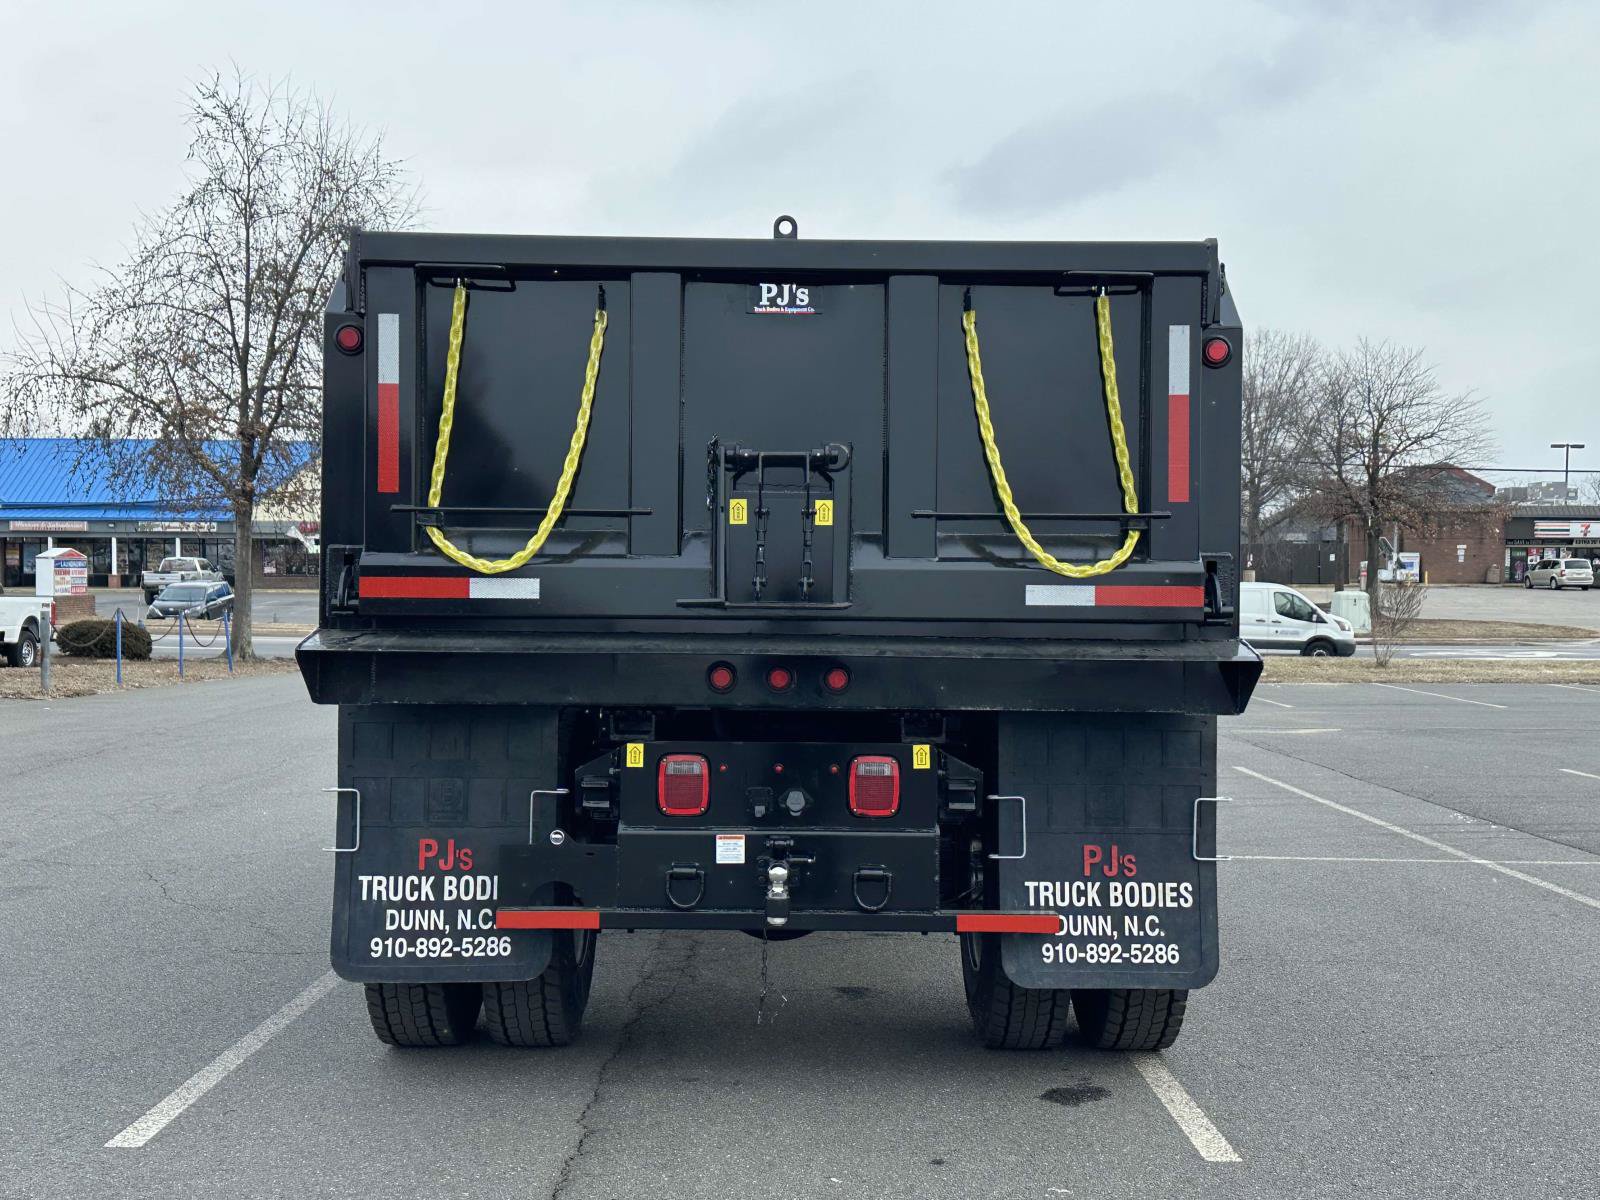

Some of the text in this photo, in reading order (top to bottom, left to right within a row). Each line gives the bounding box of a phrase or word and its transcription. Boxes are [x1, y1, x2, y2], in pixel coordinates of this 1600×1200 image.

[759, 283, 809, 305] PJ's
[358, 875, 498, 901] TRUCK BODI
[1024, 881, 1193, 908] TRUCK BODIES
[385, 908, 497, 935] DUNN, N.C.
[1055, 915, 1165, 940] DUNN, N.C.
[370, 936, 512, 958] 910-892-5286
[1042, 943, 1180, 964] 910-892-5286
